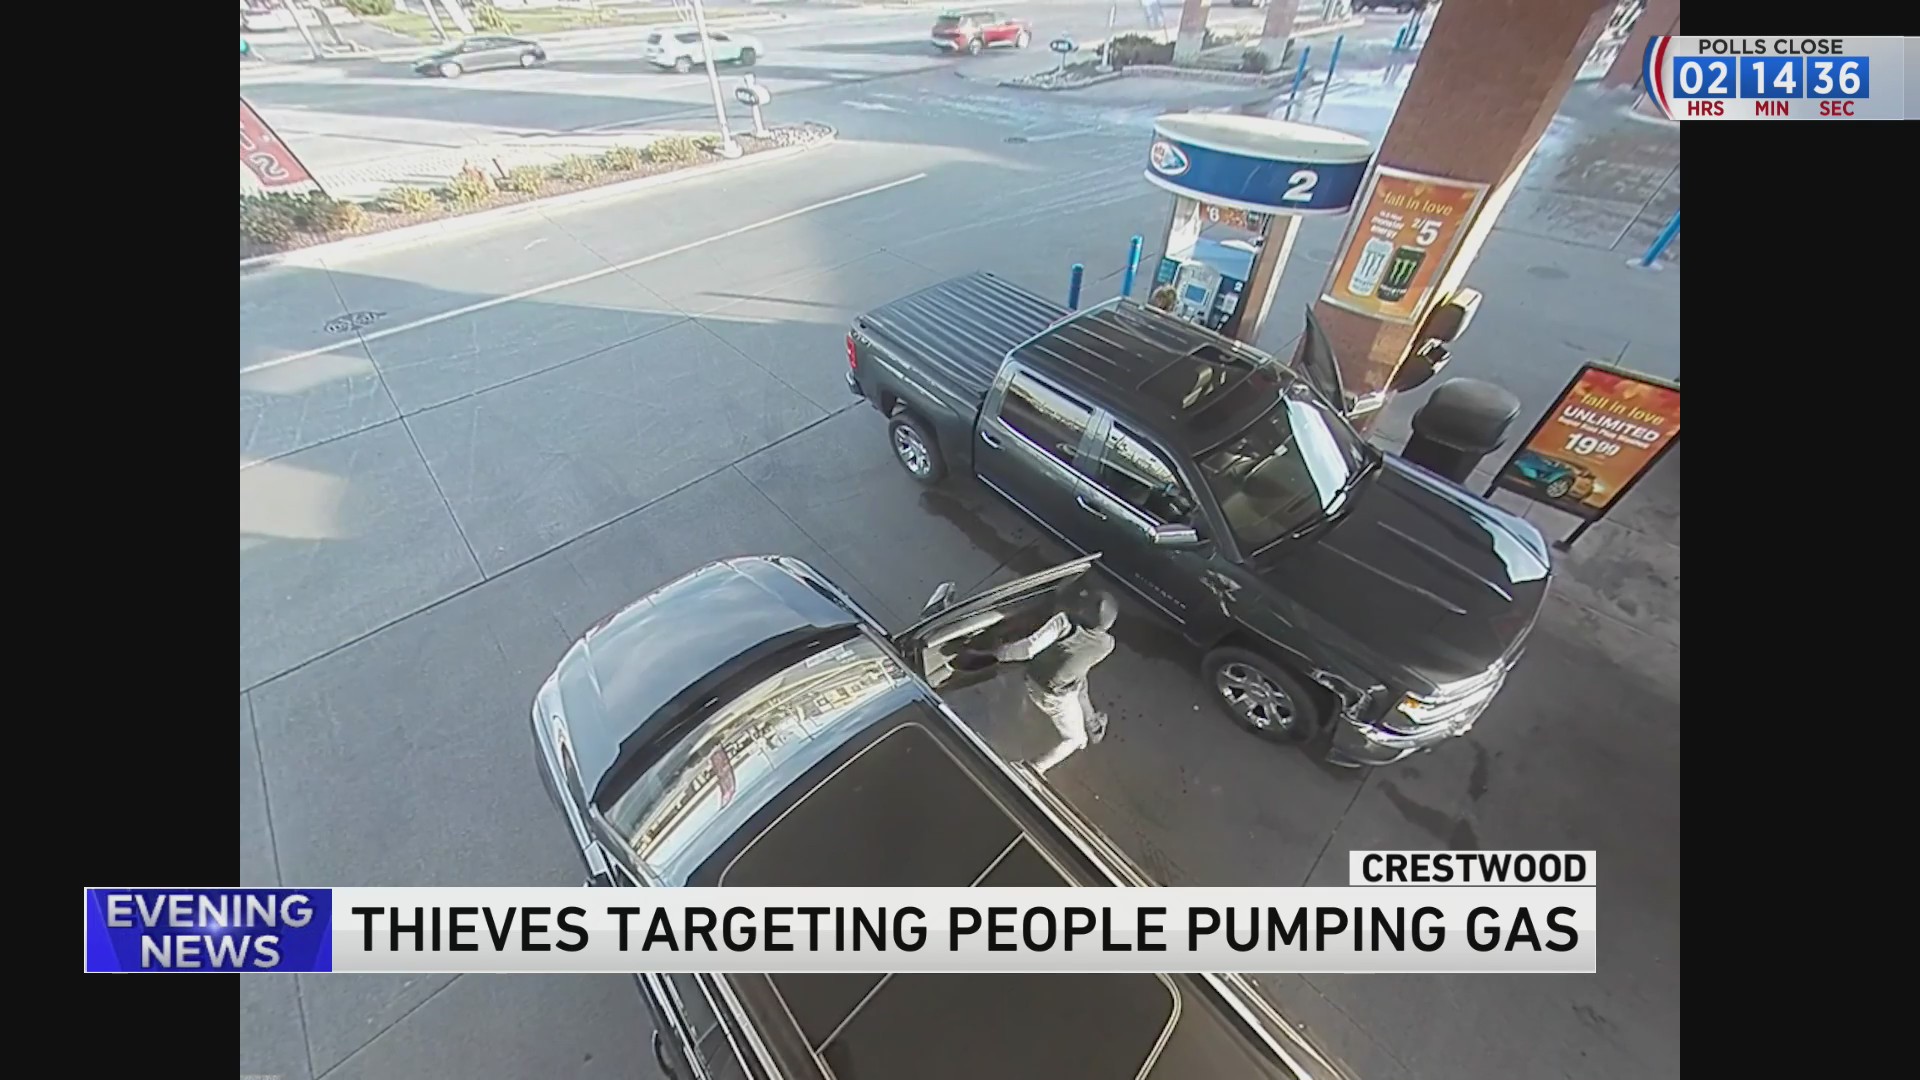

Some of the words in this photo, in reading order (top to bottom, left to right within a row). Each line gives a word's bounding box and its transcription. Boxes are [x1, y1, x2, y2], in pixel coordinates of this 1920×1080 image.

[1282, 170, 1318, 202] 2
[1383, 191, 1405, 207] fall
[1406, 198, 1419, 210] in
[1422, 200, 1453, 216] love
[1563, 405, 1660, 442] UNLIMITED
[1581, 393, 1608, 410] fall
[1609, 400, 1626, 414] in
[1628, 406, 1665, 425] love
